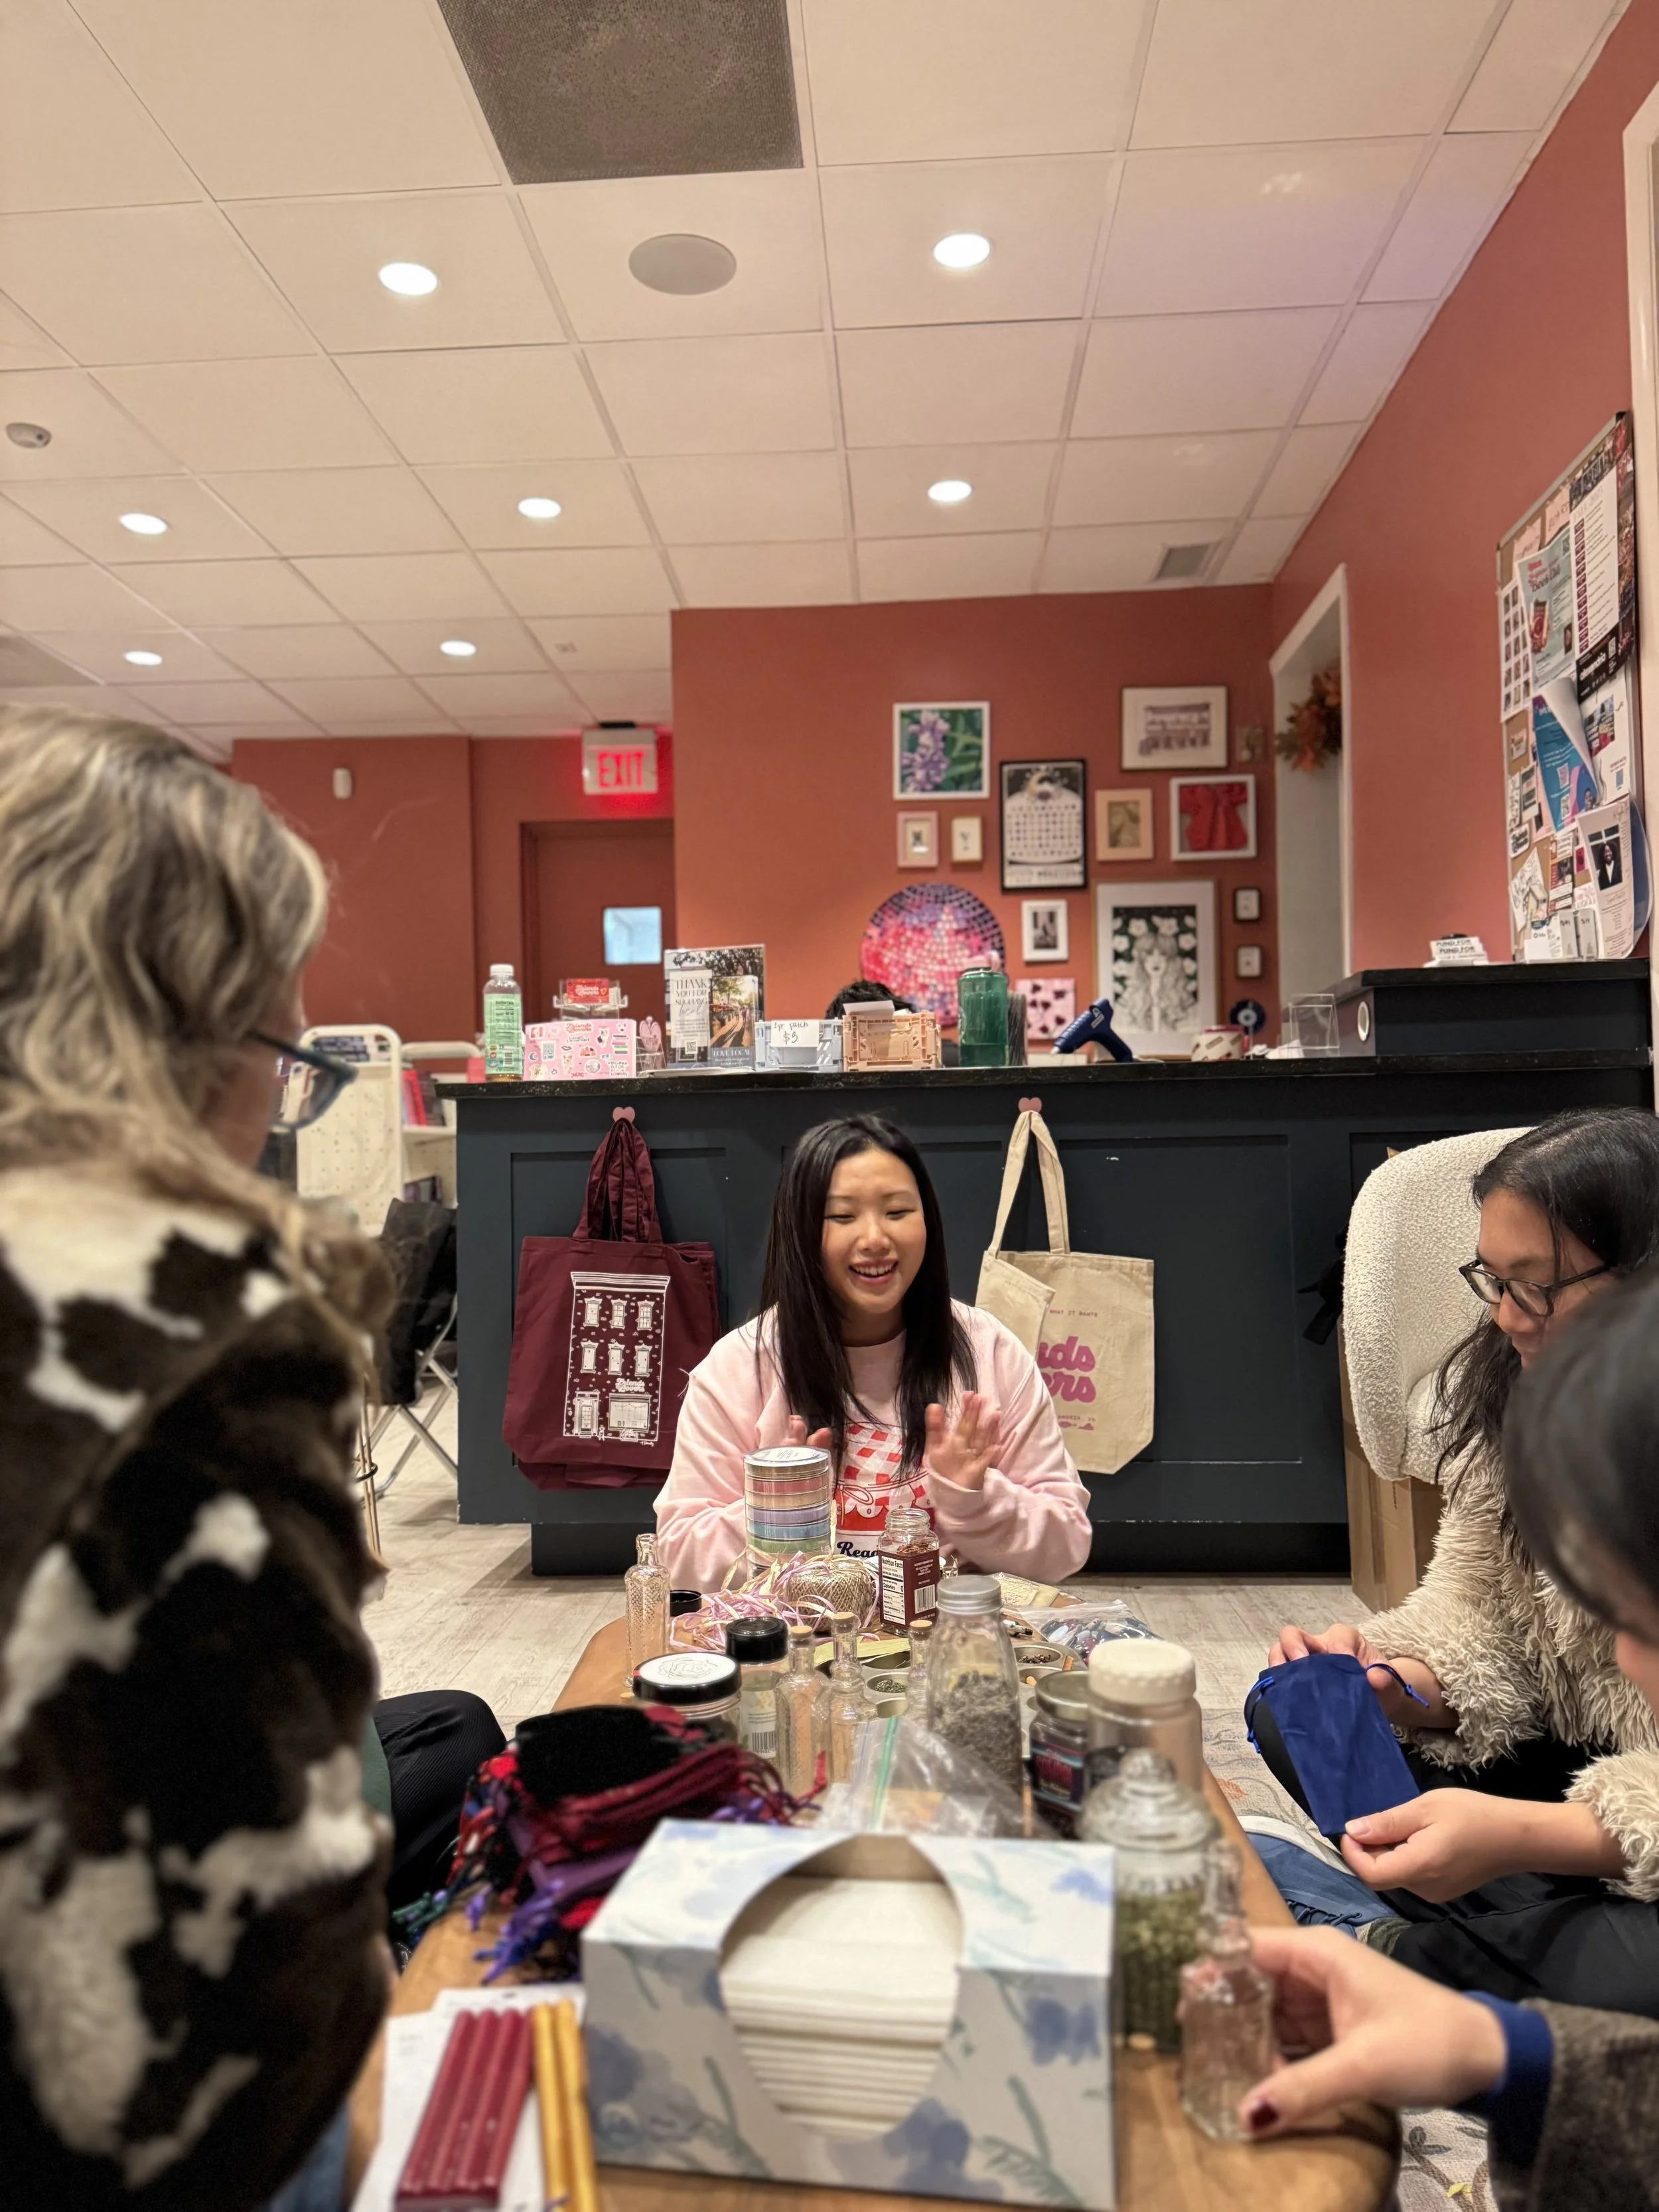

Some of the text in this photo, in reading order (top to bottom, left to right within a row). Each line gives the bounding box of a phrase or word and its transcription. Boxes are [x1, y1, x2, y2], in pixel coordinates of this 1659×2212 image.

[598, 752, 645, 788] EXIT
[676, 978, 707, 990] THANK
[789, 1021, 808, 1030] patch
[883, 1558, 895, 1566] Nutrition
